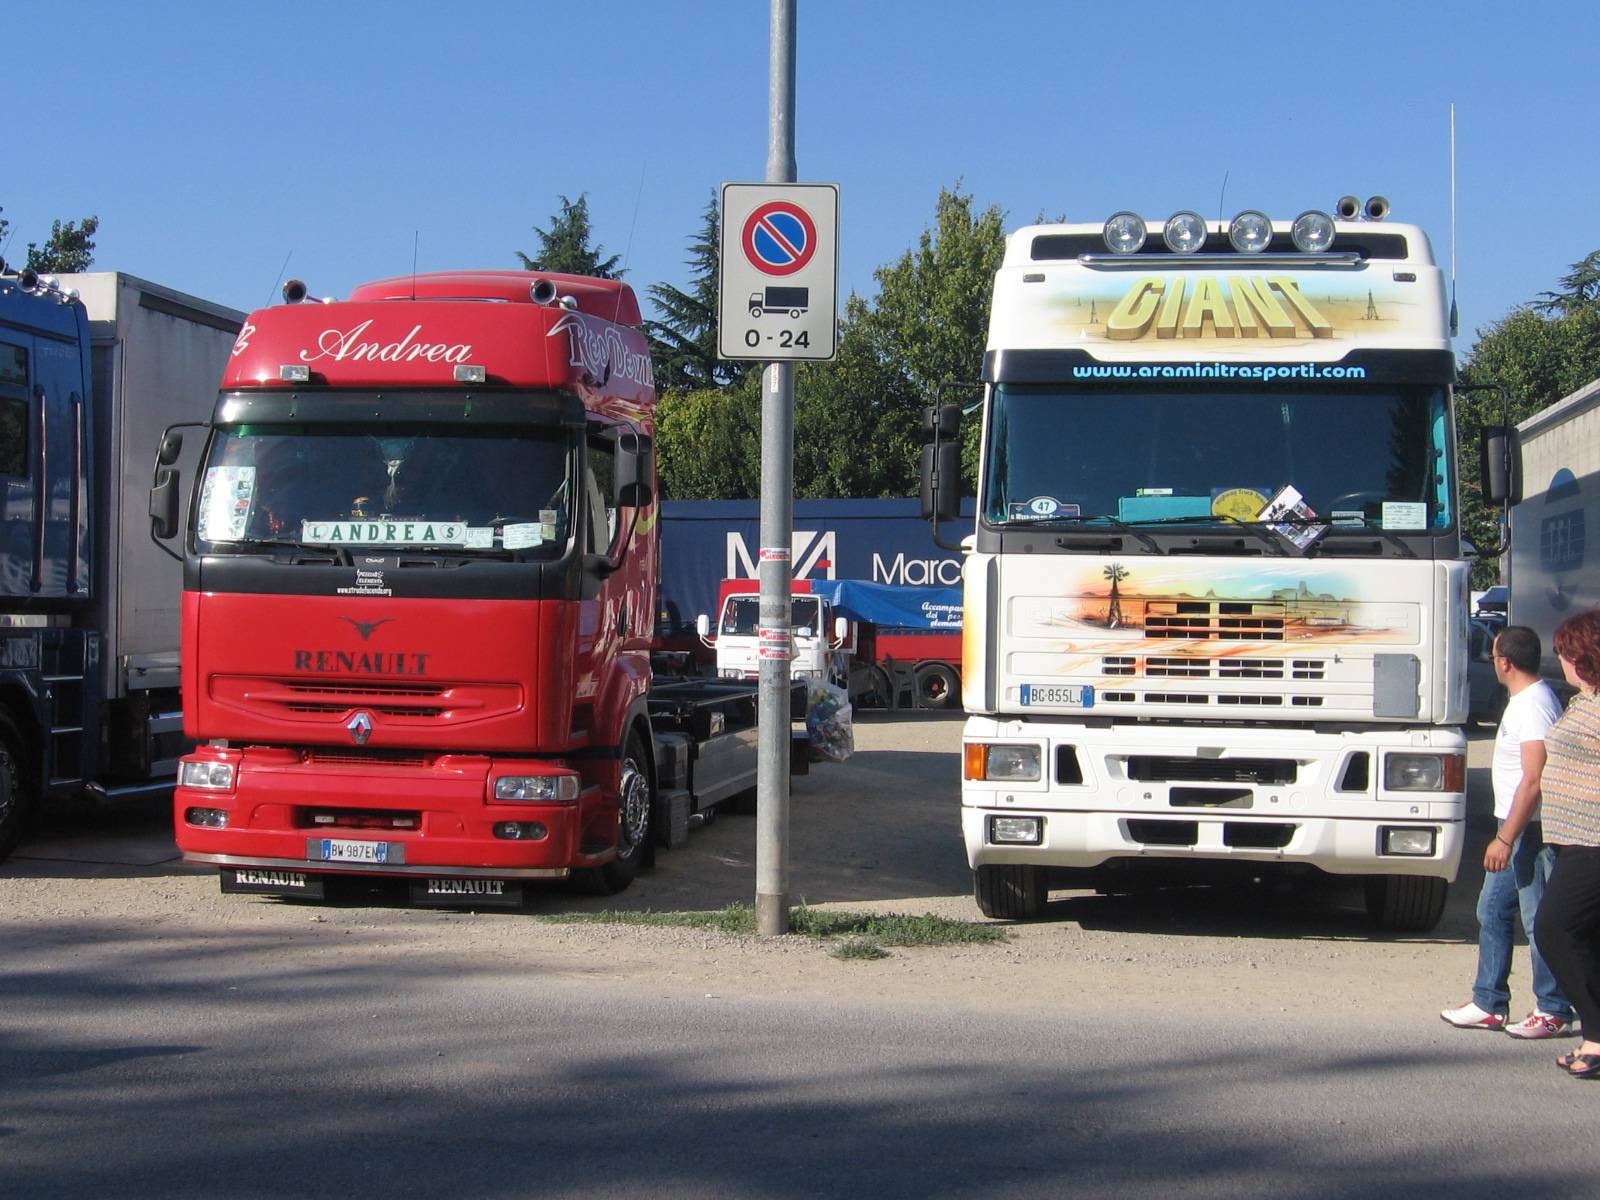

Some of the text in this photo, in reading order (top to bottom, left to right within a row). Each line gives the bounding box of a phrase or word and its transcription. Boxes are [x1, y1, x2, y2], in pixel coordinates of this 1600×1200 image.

[1106, 276, 1333, 340] GIANT
[300, 319, 473, 363] Andrea
[745, 329, 760, 347] 0
[779, 330, 810, 348] 24
[1073, 362, 1366, 381] www.araminitrasporti.com
[1038, 501, 1050, 511] 47
[295, 650, 431, 675] RENAULT
[235, 870, 307, 887] RENAULT
[427, 879, 505, 895] RENAULT
